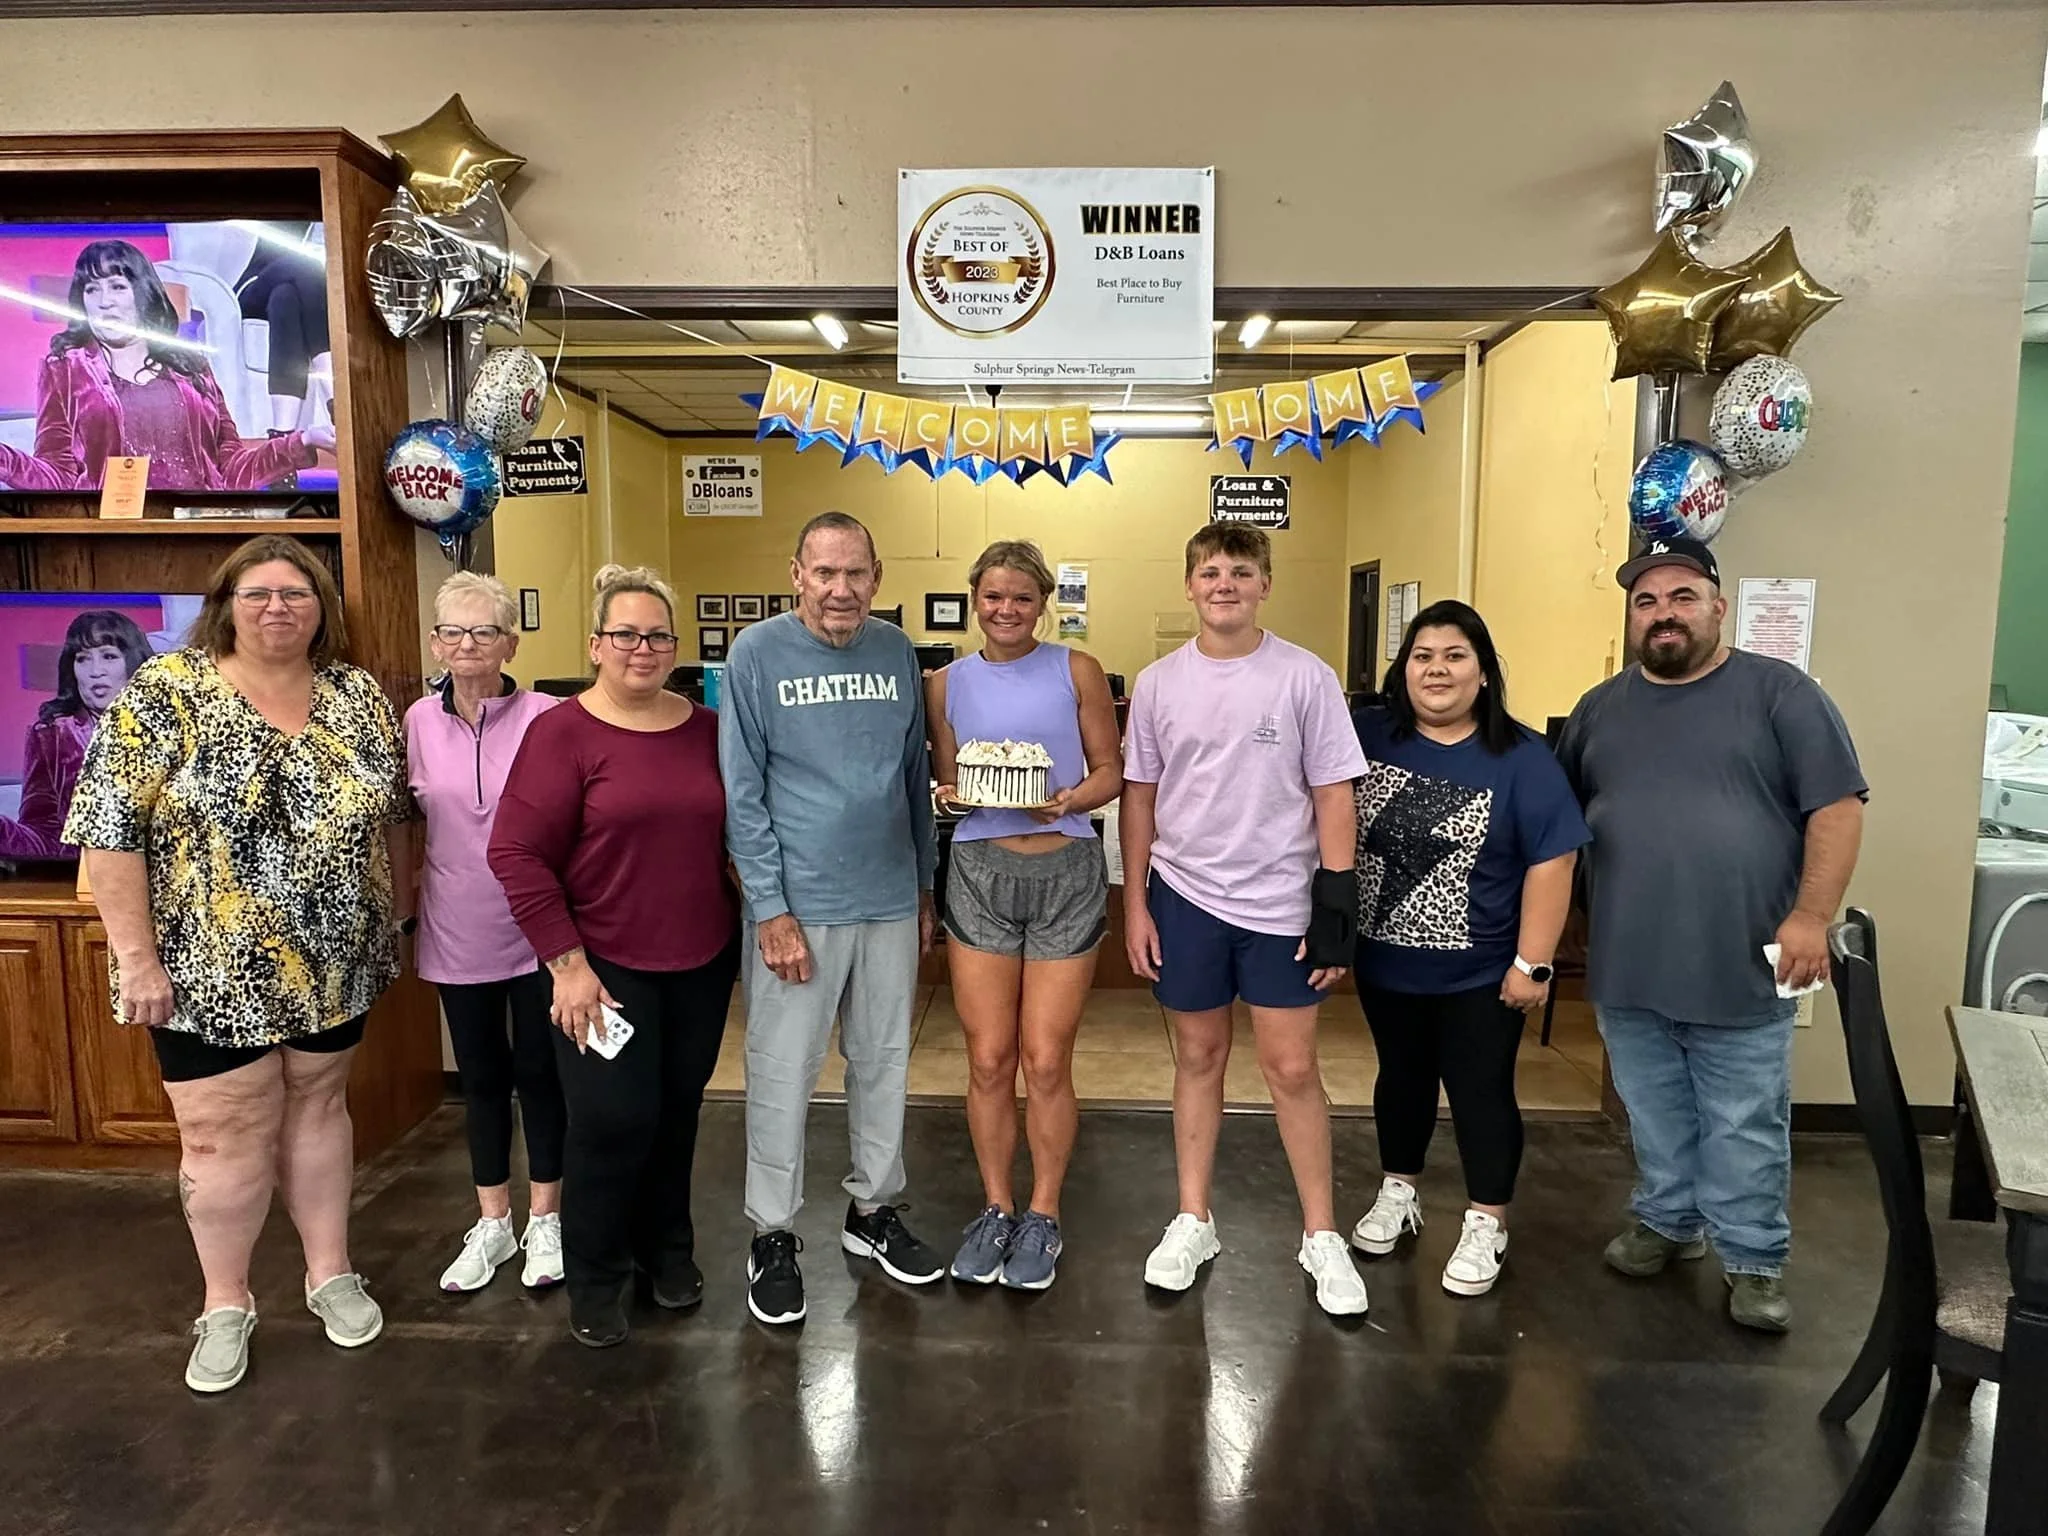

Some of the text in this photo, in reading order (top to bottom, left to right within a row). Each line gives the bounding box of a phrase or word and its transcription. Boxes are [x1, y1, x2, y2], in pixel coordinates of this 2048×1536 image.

[1080, 203, 1200, 235] WINNER
[1095, 245, 1185, 260] D&B Loans
[965, 265, 1000, 279] 2023
[1096, 278, 1182, 291] Best Place to Buy
[1116, 293, 1165, 304] Furniture
[973, 362, 1136, 377] Sulphur Springs News-Telegram
[775, 370, 1401, 450] WELCOME HOME
[510, 445, 548, 456] oan
[506, 459, 579, 473] Furniture
[386, 464, 464, 489] WELCOME
[508, 474, 580, 490] Payments
[401, 482, 449, 503] BACK
[692, 482, 753, 498] DBloans
[1221, 479, 1274, 491] Loan &
[1216, 495, 1284, 507] Furniture
[1216, 509, 1284, 521] Payments
[1649, 540, 1670, 556] LA
[777, 672, 899, 707] CHATHAM
